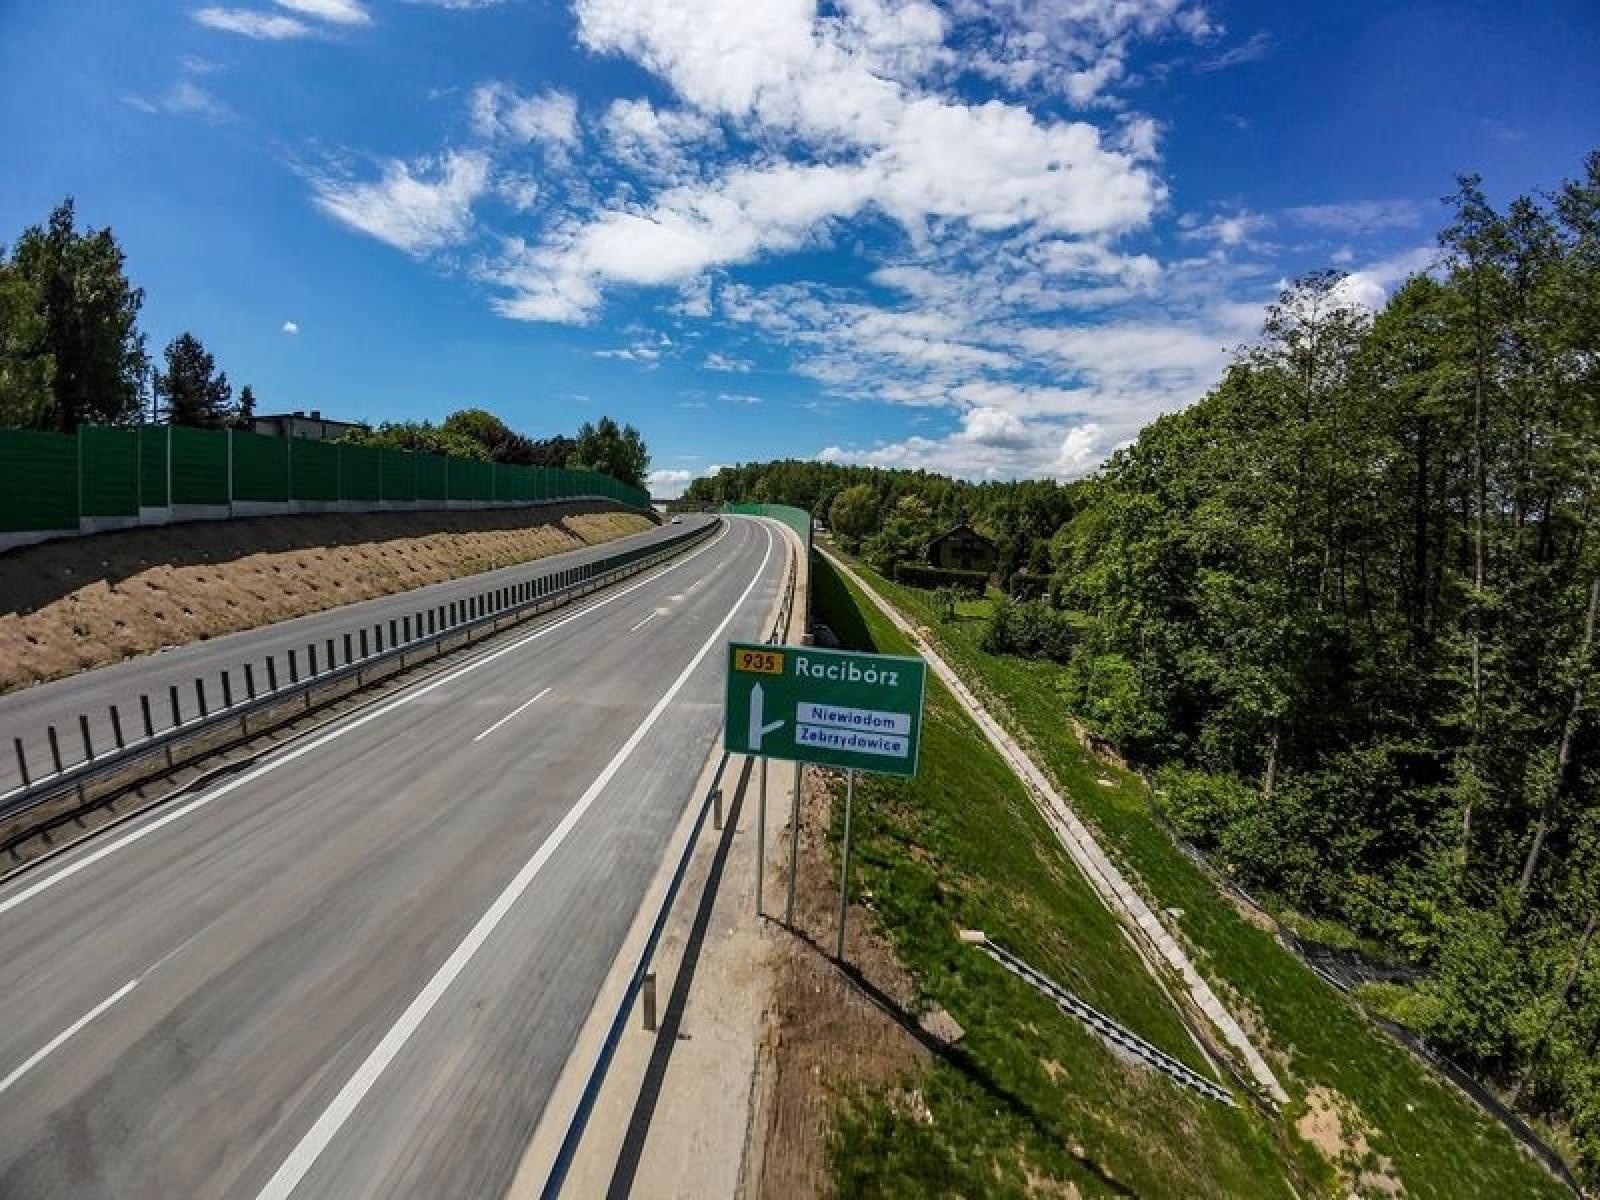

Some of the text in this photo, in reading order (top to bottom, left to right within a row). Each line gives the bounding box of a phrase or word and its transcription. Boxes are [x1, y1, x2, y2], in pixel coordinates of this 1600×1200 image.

[743, 653, 775, 670] 935
[795, 656, 899, 687] Racibórz
[811, 707, 895, 729] Niewiadom
[800, 727, 901, 751] Zebrzydowice
